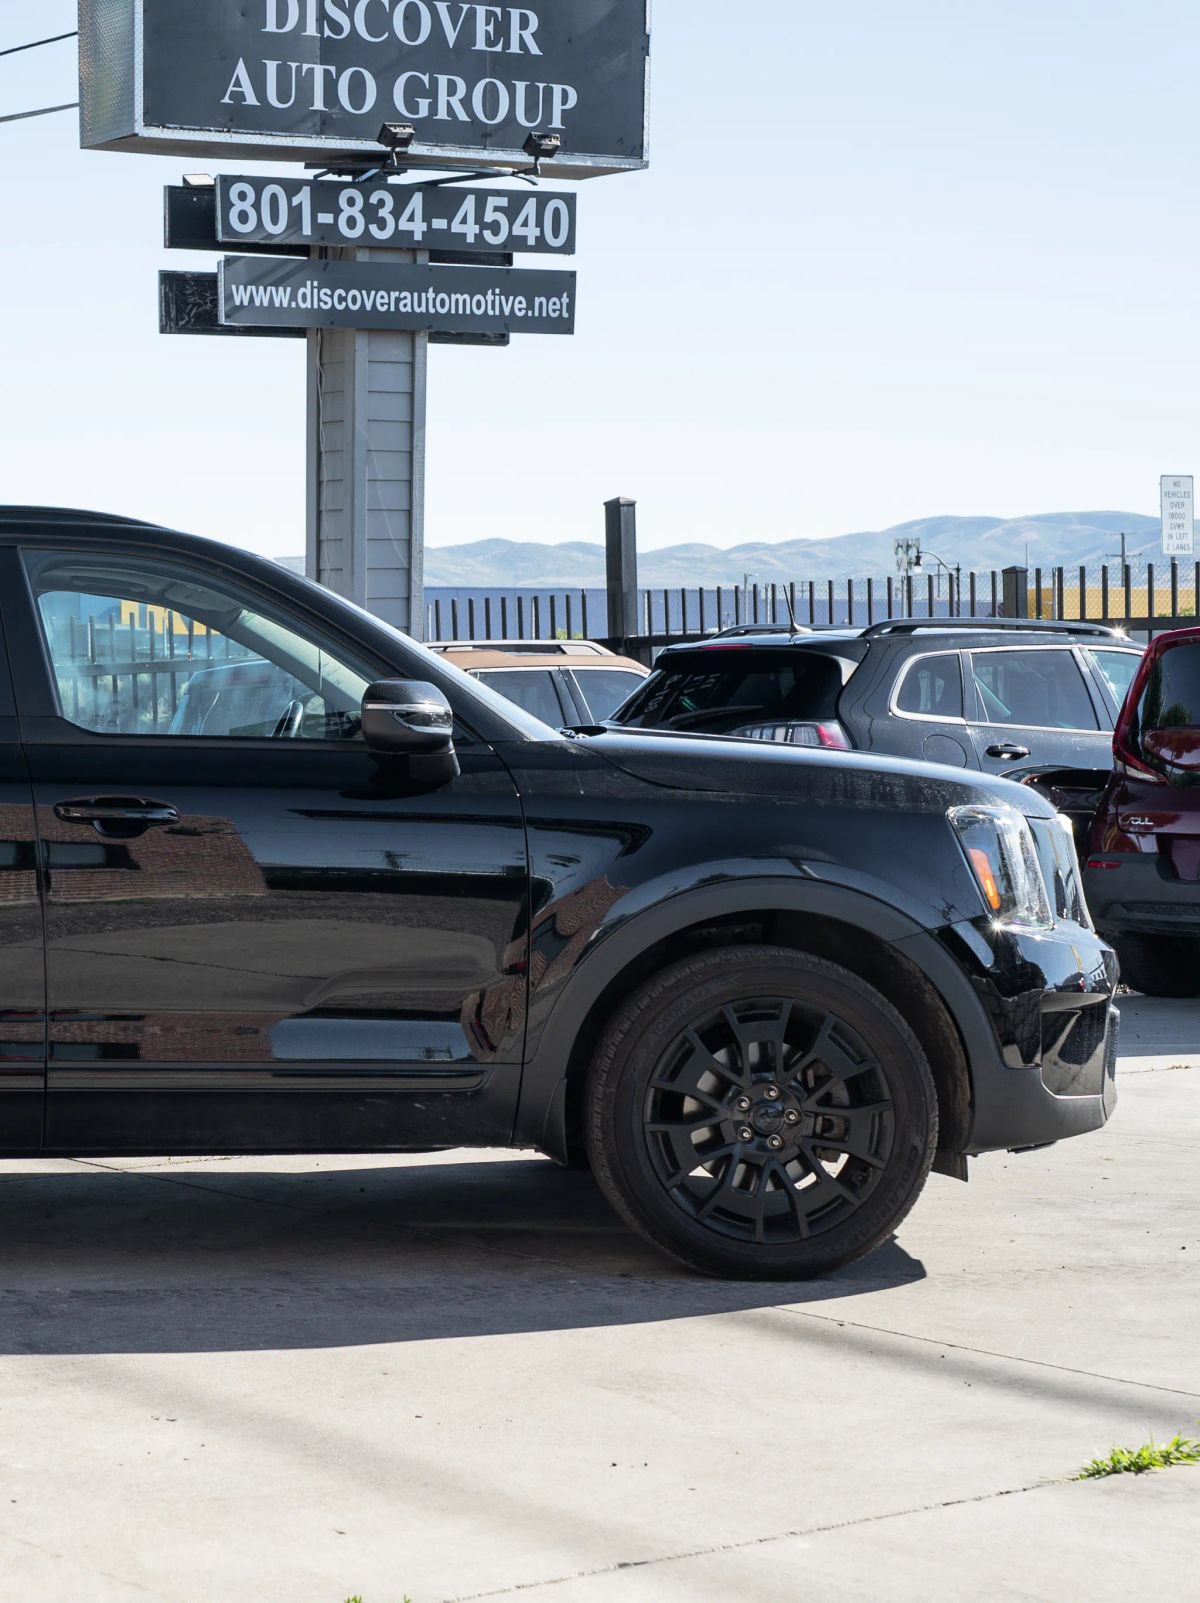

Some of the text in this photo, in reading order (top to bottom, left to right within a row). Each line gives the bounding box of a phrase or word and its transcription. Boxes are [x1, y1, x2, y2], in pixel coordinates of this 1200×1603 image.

[261, 0, 544, 56] DISCOVER
[220, 57, 578, 129] AUTO GROUP
[229, 182, 569, 247] 801-834-4540
[231, 281, 570, 318] www.discoverautomotive.net
[1164, 491, 1190, 499] VEHICLES
[1173, 480, 1181, 488] NO
[1168, 512, 1186, 520] 18000
[1170, 501, 1185, 509] OVER
[1168, 532, 1189, 540] IN LEFT
[649, 985, 714, 1038] YOKOHAMA
